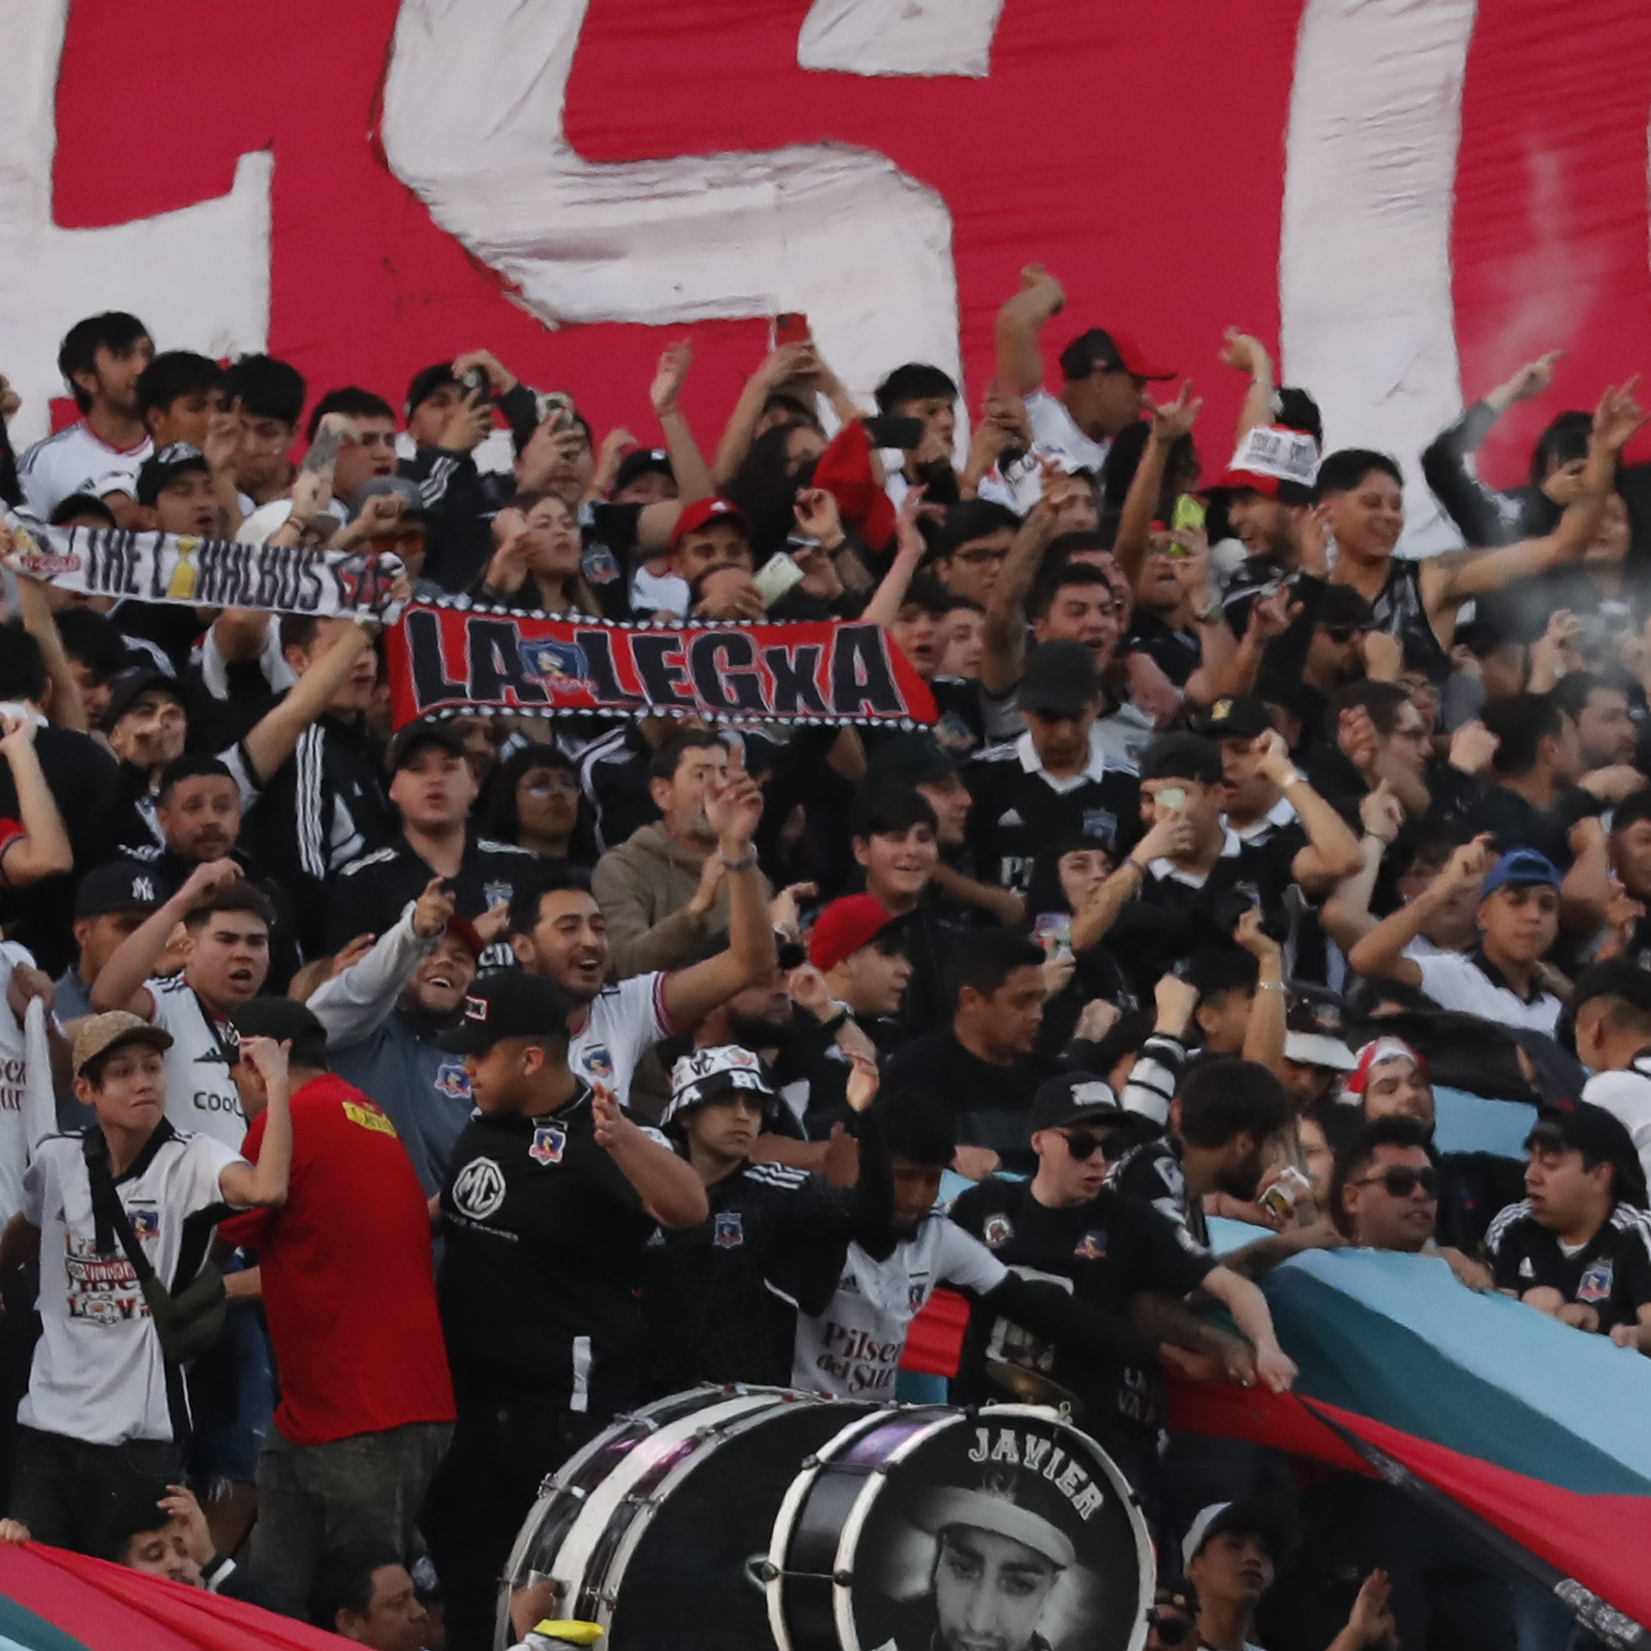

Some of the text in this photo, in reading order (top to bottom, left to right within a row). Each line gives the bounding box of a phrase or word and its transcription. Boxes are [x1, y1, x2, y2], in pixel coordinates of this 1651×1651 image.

[87, 528, 140, 595] THE
[405, 606, 551, 713] LA
[193, 1091, 244, 1118] COOL
[968, 1427, 1105, 1521] JAVIER
